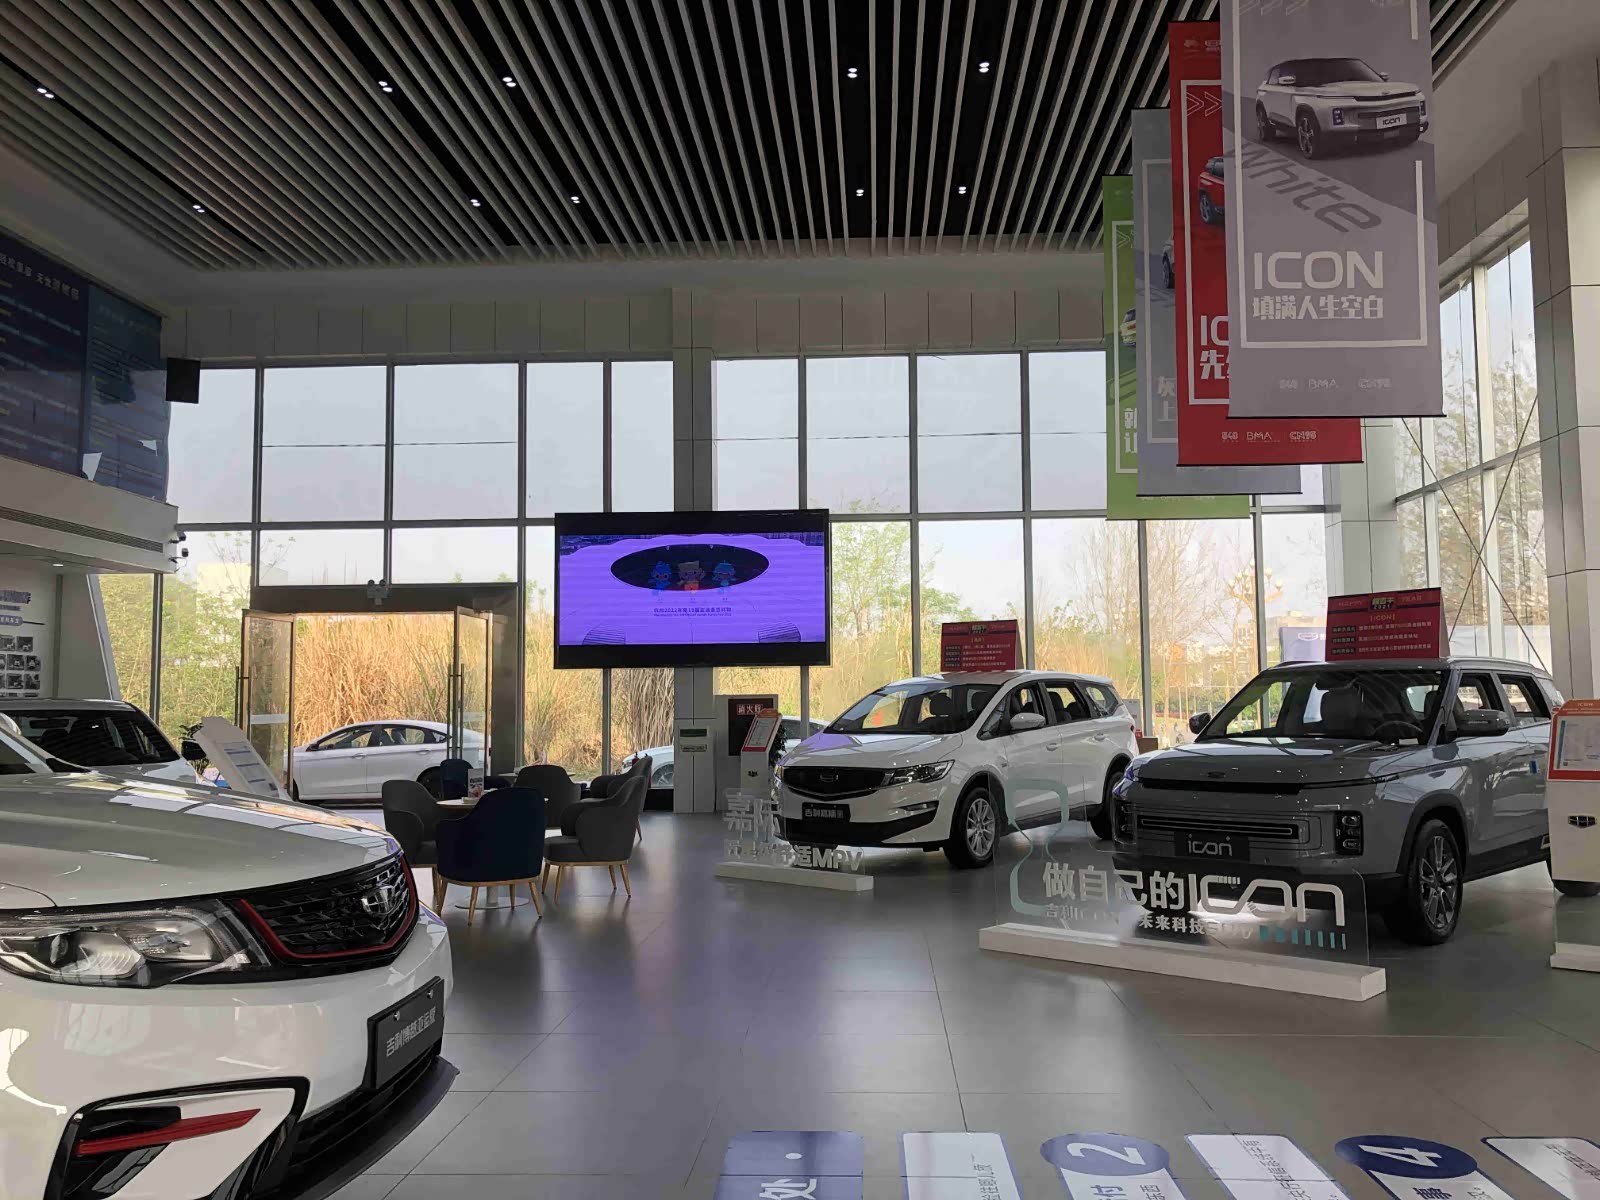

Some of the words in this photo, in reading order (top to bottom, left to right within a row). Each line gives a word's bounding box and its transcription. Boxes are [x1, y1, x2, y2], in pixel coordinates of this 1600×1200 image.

[1254, 250, 1384, 290] ICON
[1252, 294, 1384, 321] 填满人生空白
[1200, 314, 1230, 346] IC
[1199, 349, 1230, 380] 先
[1308, 378, 1338, 390] BMA
[1246, 431, 1273, 441] BMA
[1066, 1142, 1147, 1165] 2
[1357, 1144, 1443, 1168] 4
